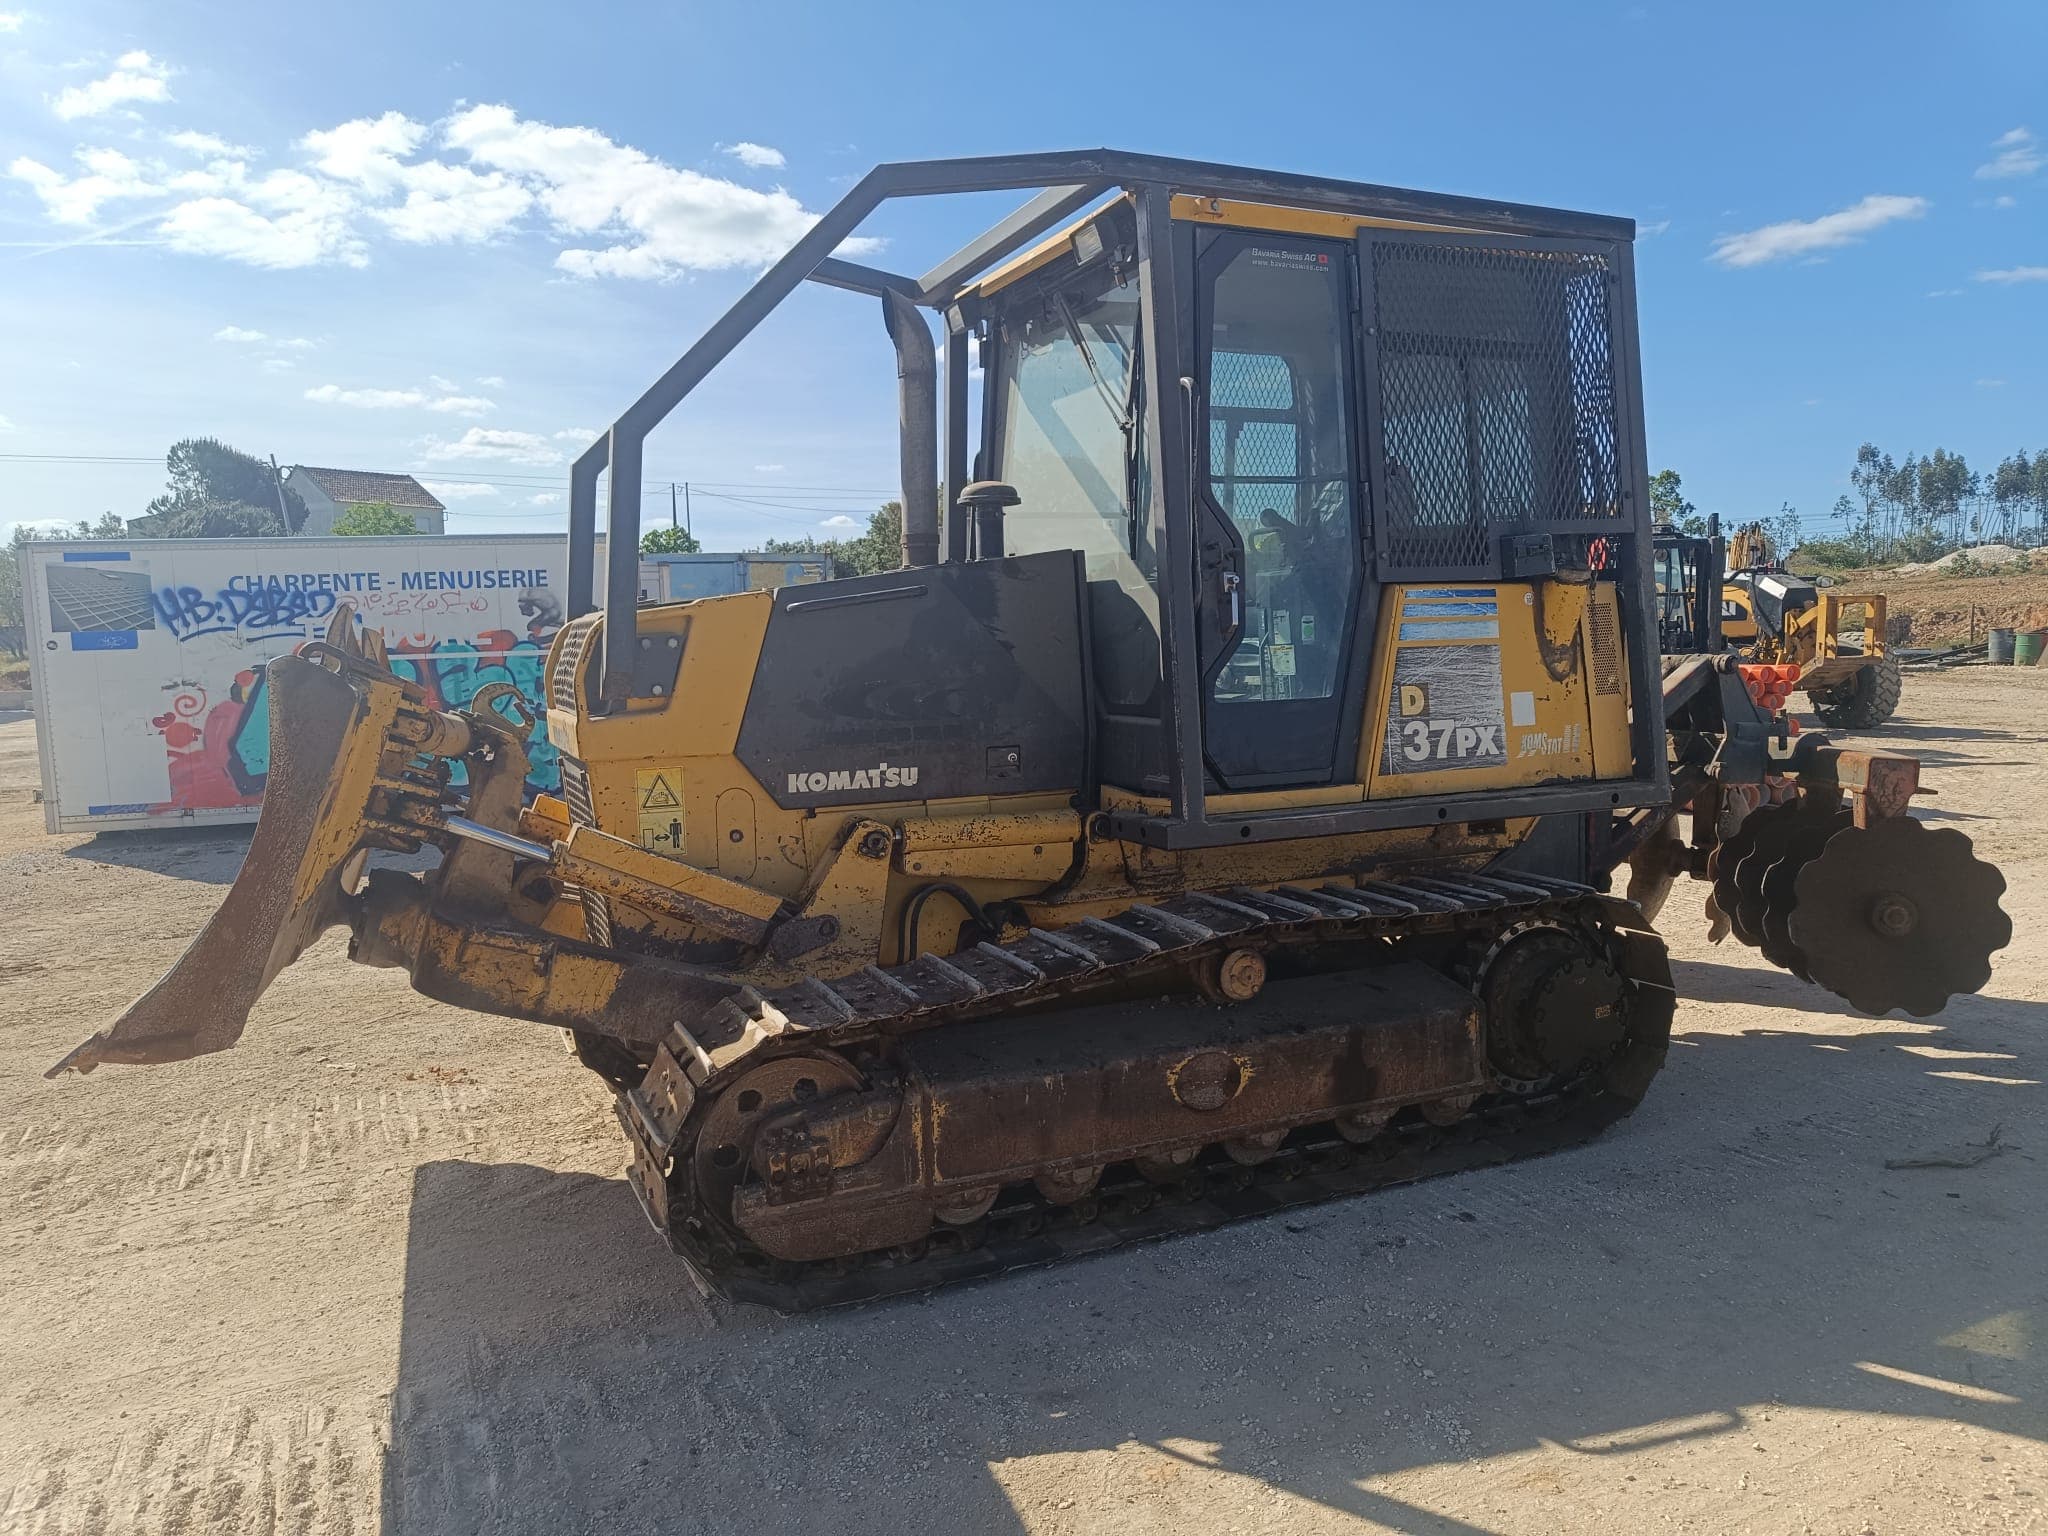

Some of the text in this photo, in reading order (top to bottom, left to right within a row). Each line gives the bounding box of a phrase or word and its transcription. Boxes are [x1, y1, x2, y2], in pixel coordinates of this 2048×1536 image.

[1304, 253, 1317, 262] AG
[228, 572, 382, 594] CHARPENTE
[400, 568, 549, 592] MENUISERIE
[1400, 685, 1425, 716] D
[1403, 719, 1499, 762] 37PX
[787, 762, 919, 793] KOMATSU
